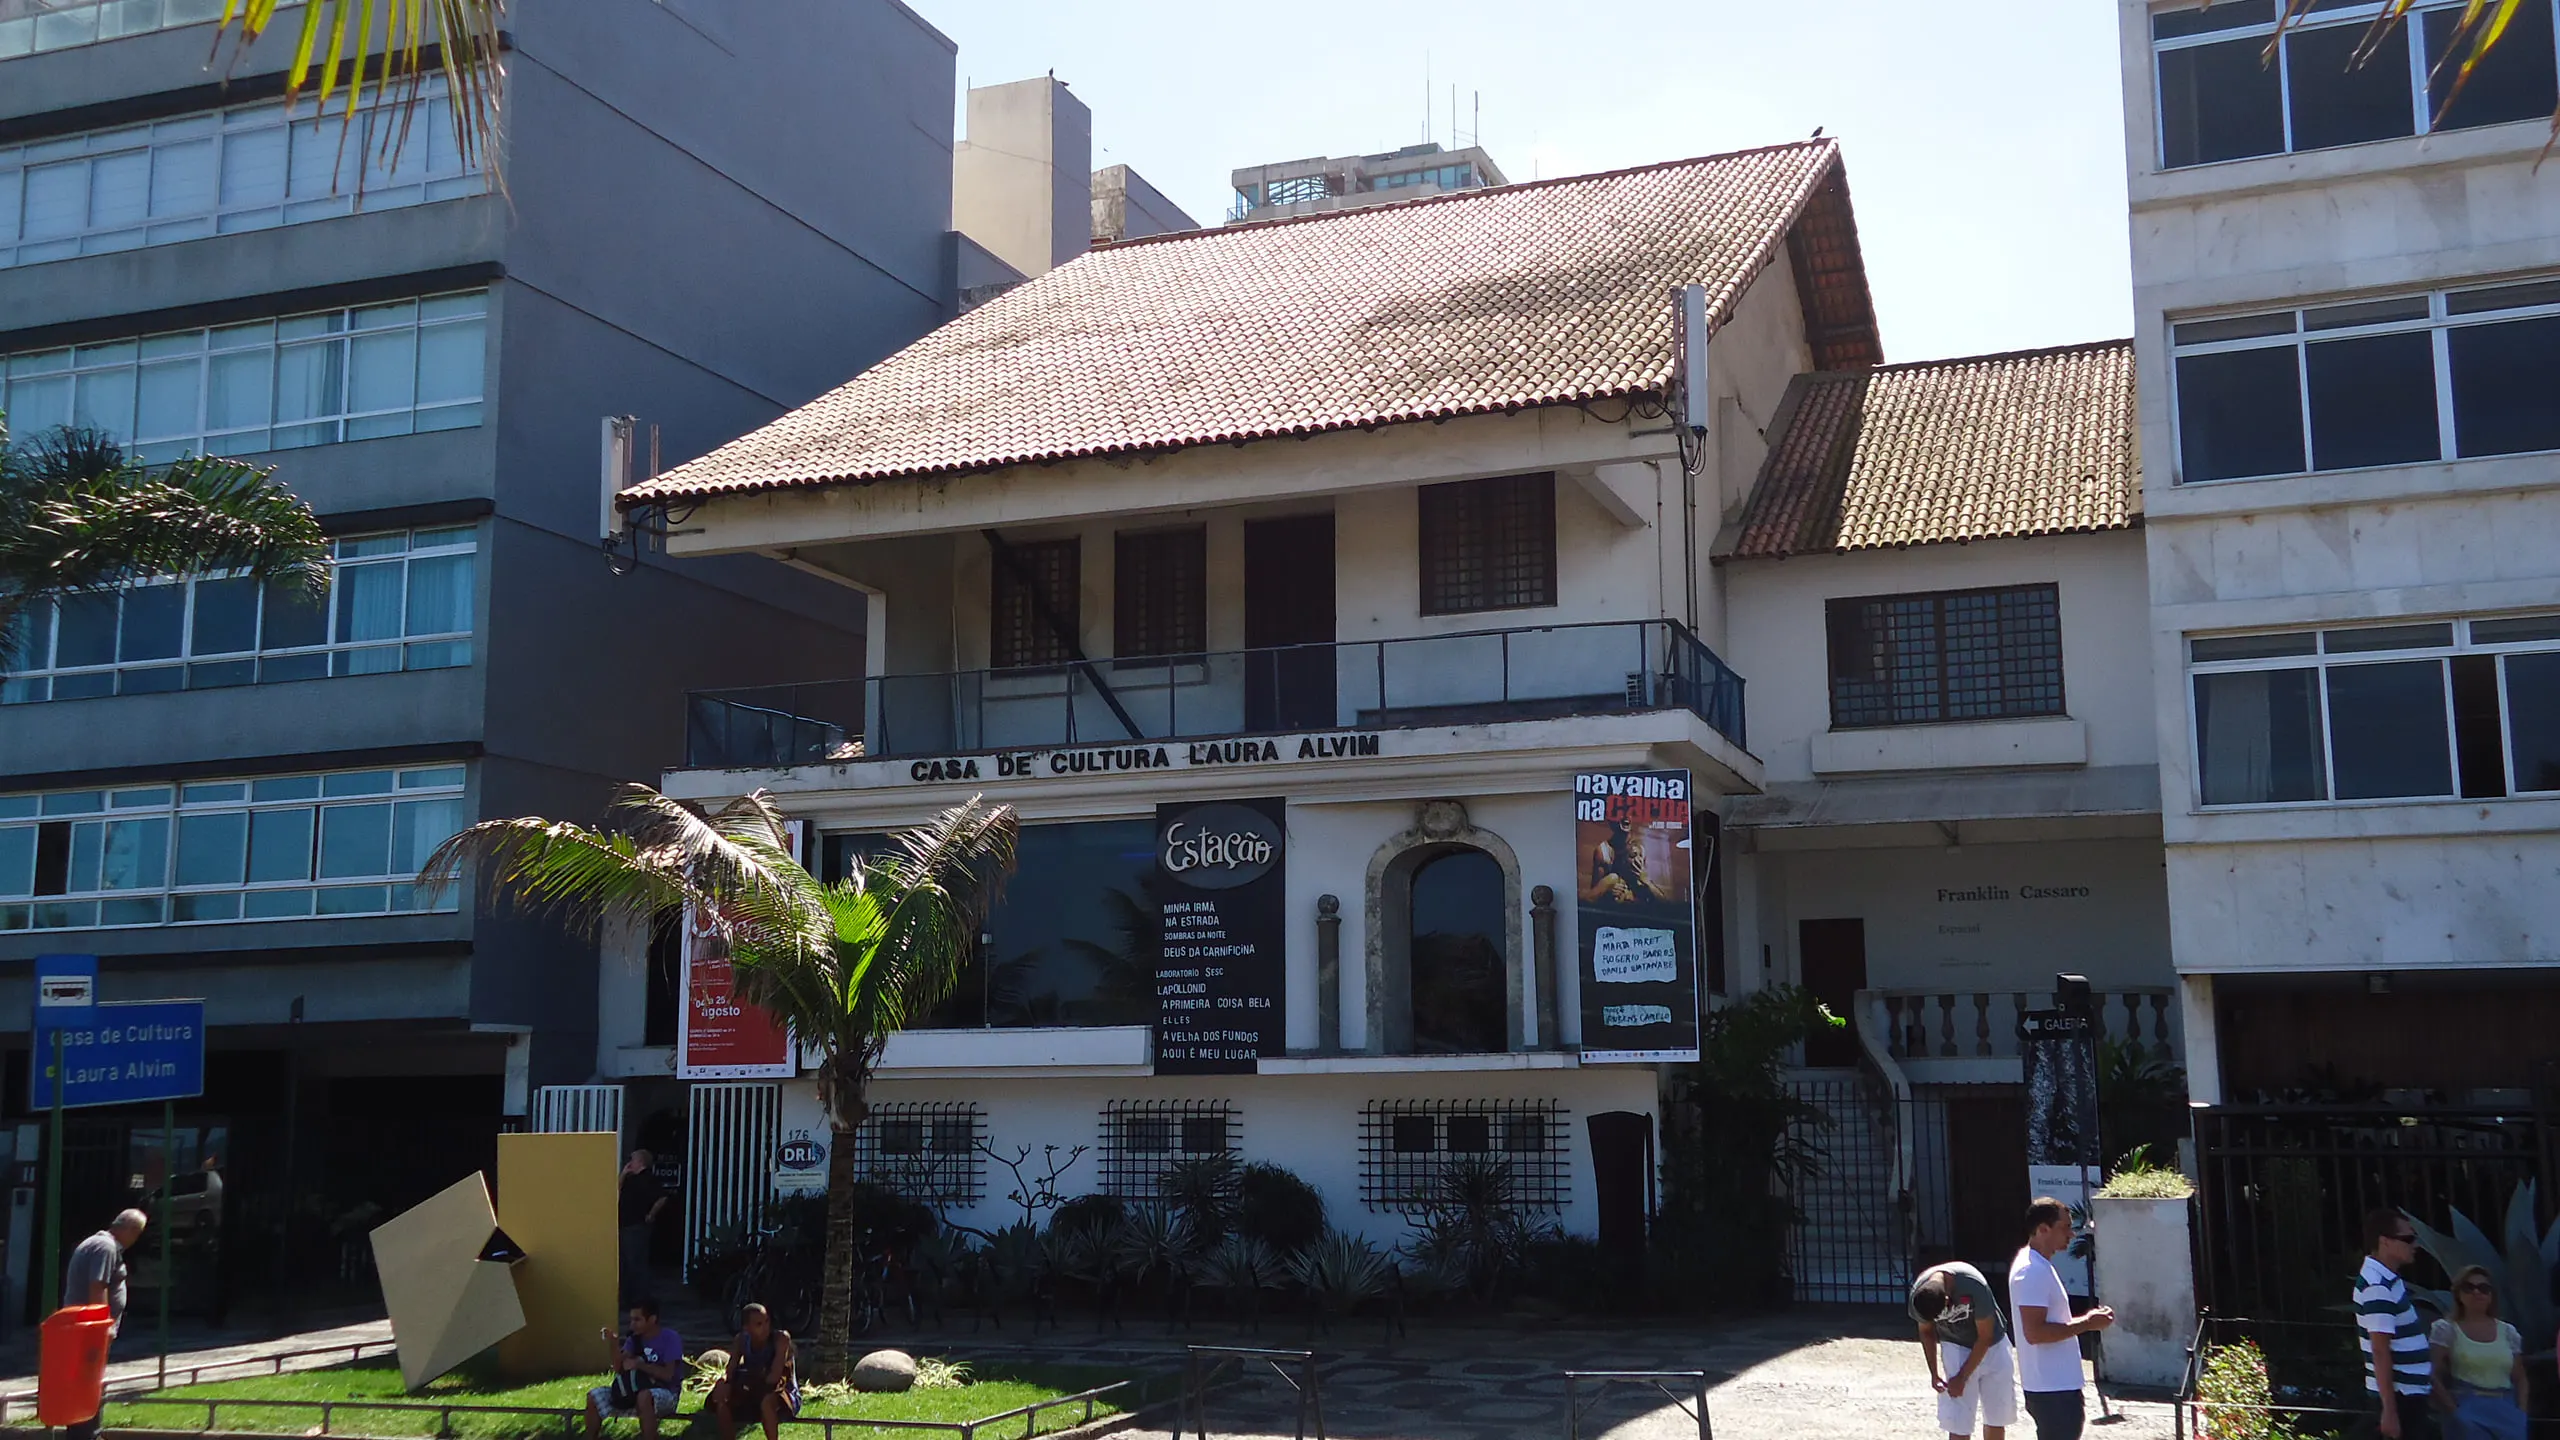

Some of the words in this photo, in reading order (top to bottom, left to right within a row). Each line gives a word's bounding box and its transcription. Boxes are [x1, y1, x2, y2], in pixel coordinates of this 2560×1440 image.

[910, 760, 979, 781] CASA
[998, 755, 1031, 777] DE
[1050, 747, 1169, 774] CULTURA
[1189, 741, 1279, 765] LAURA
[1297, 735, 1379, 758] ALVIM
[1577, 798, 1606, 821] na
[1165, 822, 1273, 872] Estação
[1937, 885, 2010, 902] Franklin
[2020, 884, 2090, 900] Cassaro
[1163, 902, 1191, 914] MINHA
[1165, 916, 1177, 927] NA
[1180, 916, 1220, 927] ESTRADA
[1164, 931, 1195, 941] SOMBRAS
[1197, 931, 1206, 940] DA
[1207, 930, 1226, 939] NOITE
[1164, 946, 1186, 958] DEUS
[1188, 946, 1200, 958] DA
[1601, 965, 1627, 977] DANILO
[1162, 1000, 1168, 1010] A
[1169, 998, 1211, 1010] PRIMEIRA
[1217, 997, 1244, 1009] COISA
[1248, 997, 1271, 1008] BELA
[701, 1006, 740, 1019] agosto
[1162, 1015, 1190, 1025] ELLES
[100, 1027, 121, 1045] de
[126, 1024, 193, 1043] Cultura
[1162, 1030, 1169, 1041] A
[1203, 1030, 1220, 1042] DOS
[1222, 1030, 1259, 1043] FUNDOS
[1162, 1048, 1185, 1059] AQUI
[1200, 1048, 1219, 1059] MEU
[1225, 1048, 1257, 1059] LUGAR
[65, 1066, 119, 1085] Laura
[125, 1058, 176, 1079] Alvim
[789, 1129, 809, 1140] 176
